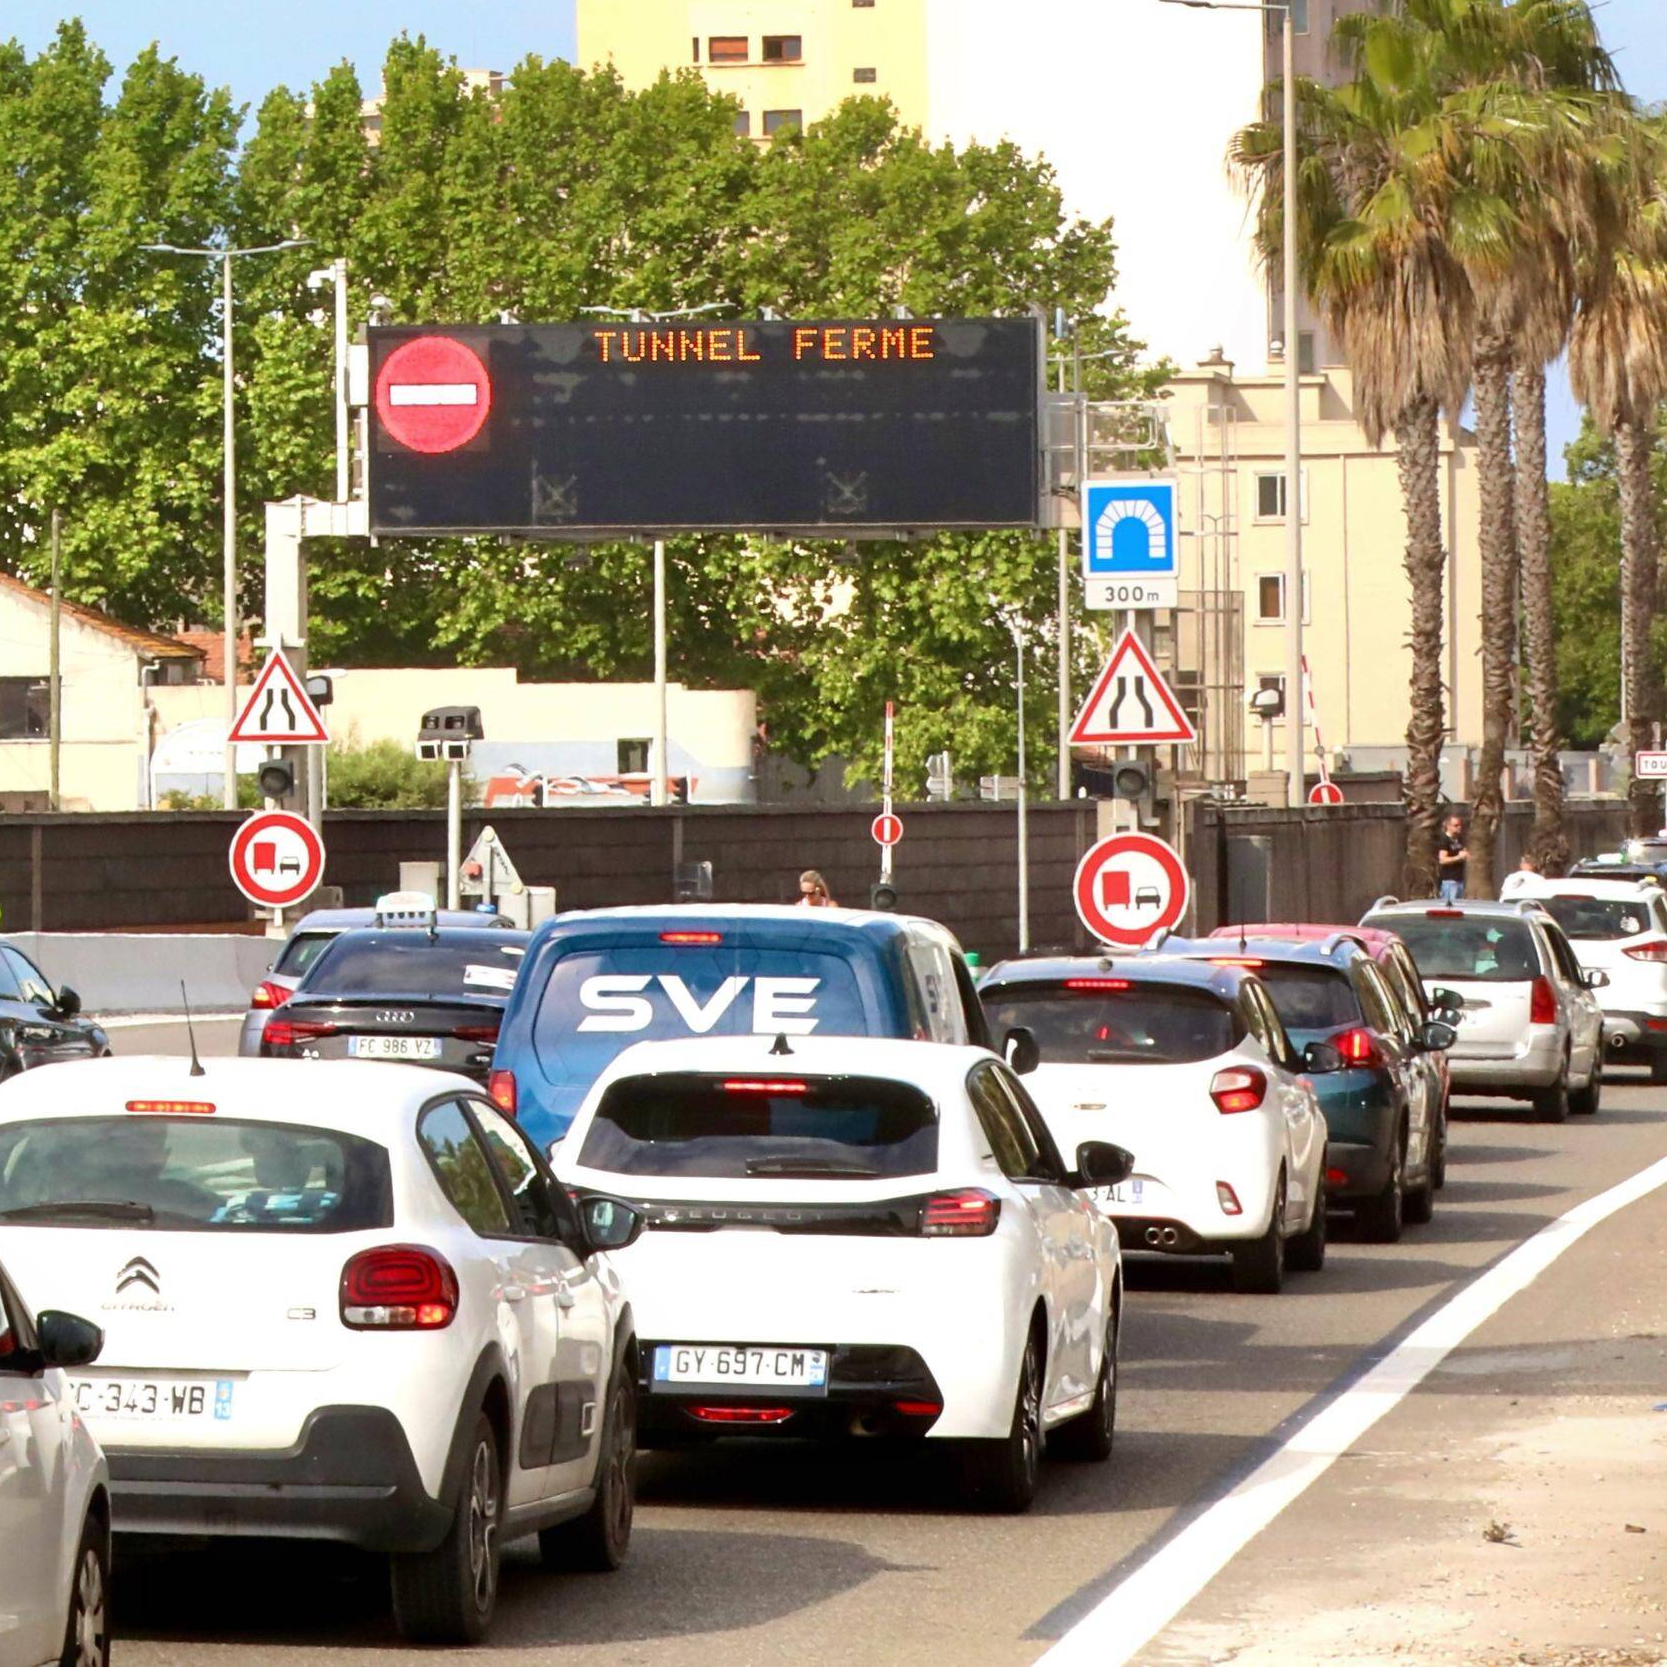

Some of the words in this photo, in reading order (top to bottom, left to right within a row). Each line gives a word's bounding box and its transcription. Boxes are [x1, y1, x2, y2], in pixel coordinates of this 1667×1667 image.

[594, 330, 761, 362] TUNNEL
[794, 326, 935, 361] FERME
[576, 975, 822, 1034] SVE
[286, 1308, 316, 1319] C3
[675, 1350, 804, 1376] GY-697-CM
